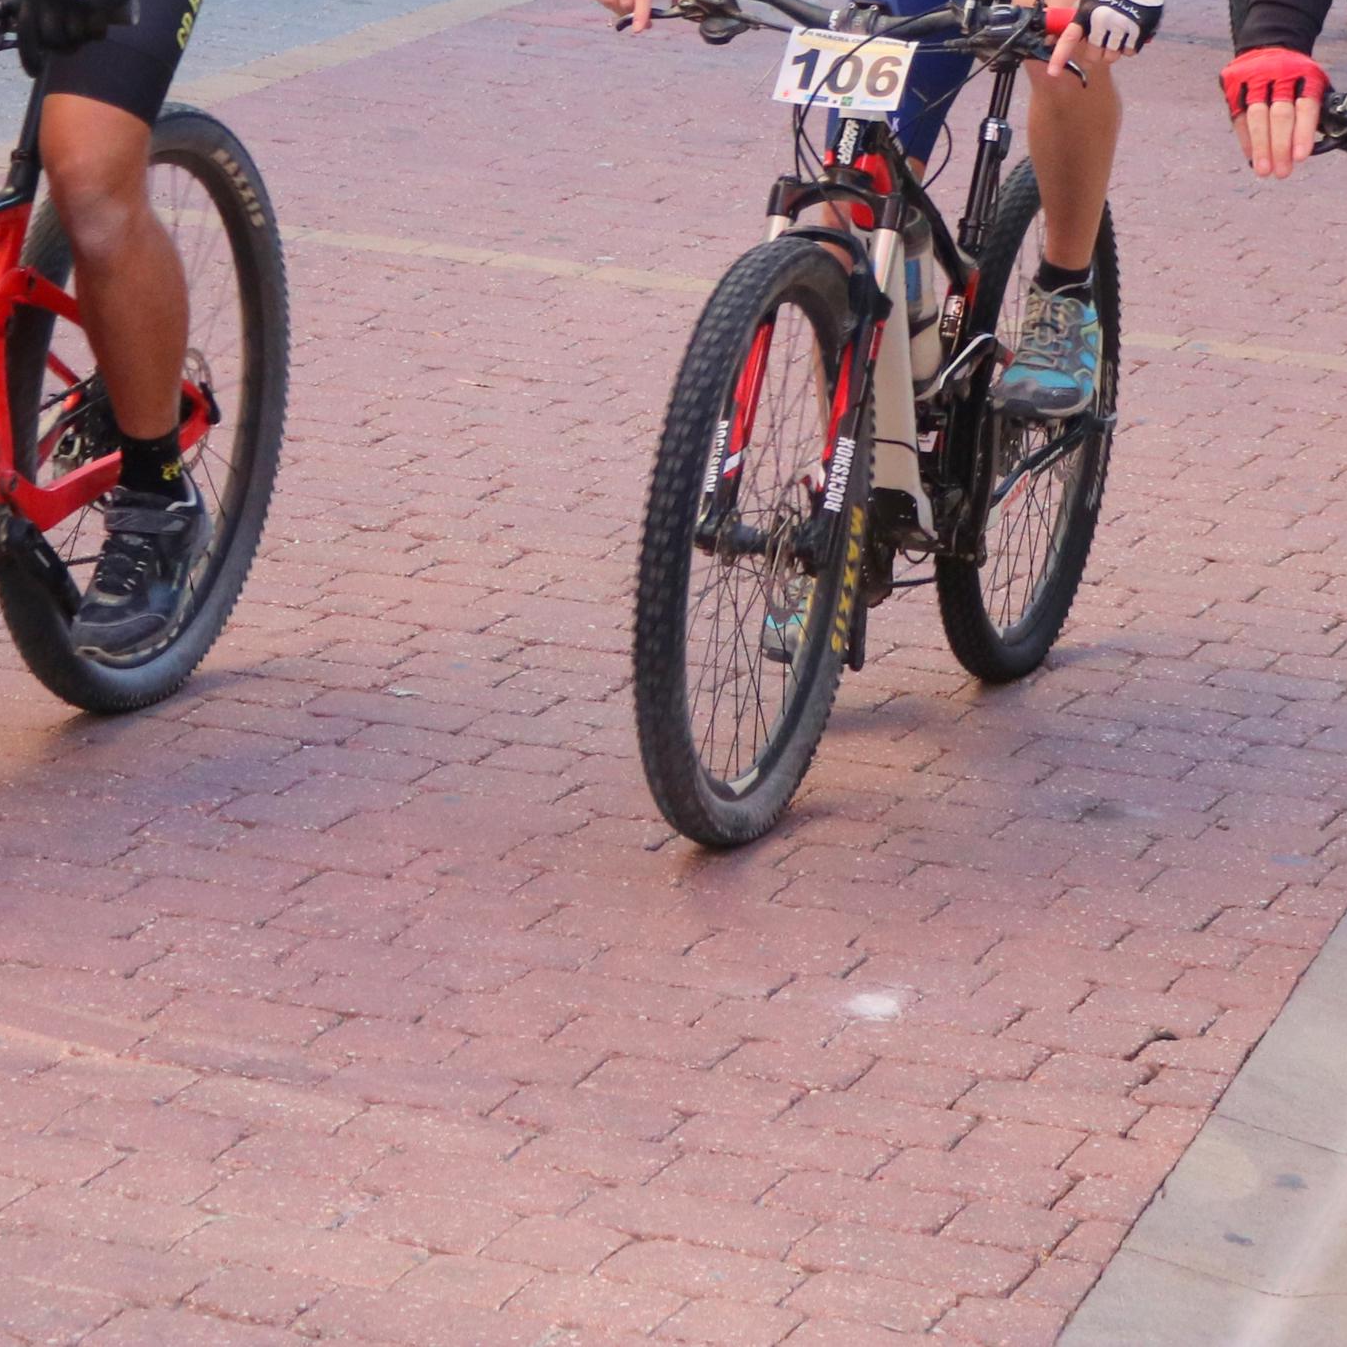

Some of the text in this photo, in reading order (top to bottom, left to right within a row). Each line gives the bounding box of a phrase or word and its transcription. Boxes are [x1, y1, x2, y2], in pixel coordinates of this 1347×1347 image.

[792, 48, 902, 97] 106
[823, 436, 856, 513] ROCKSHOX
[830, 504, 867, 653] MAXXIS
